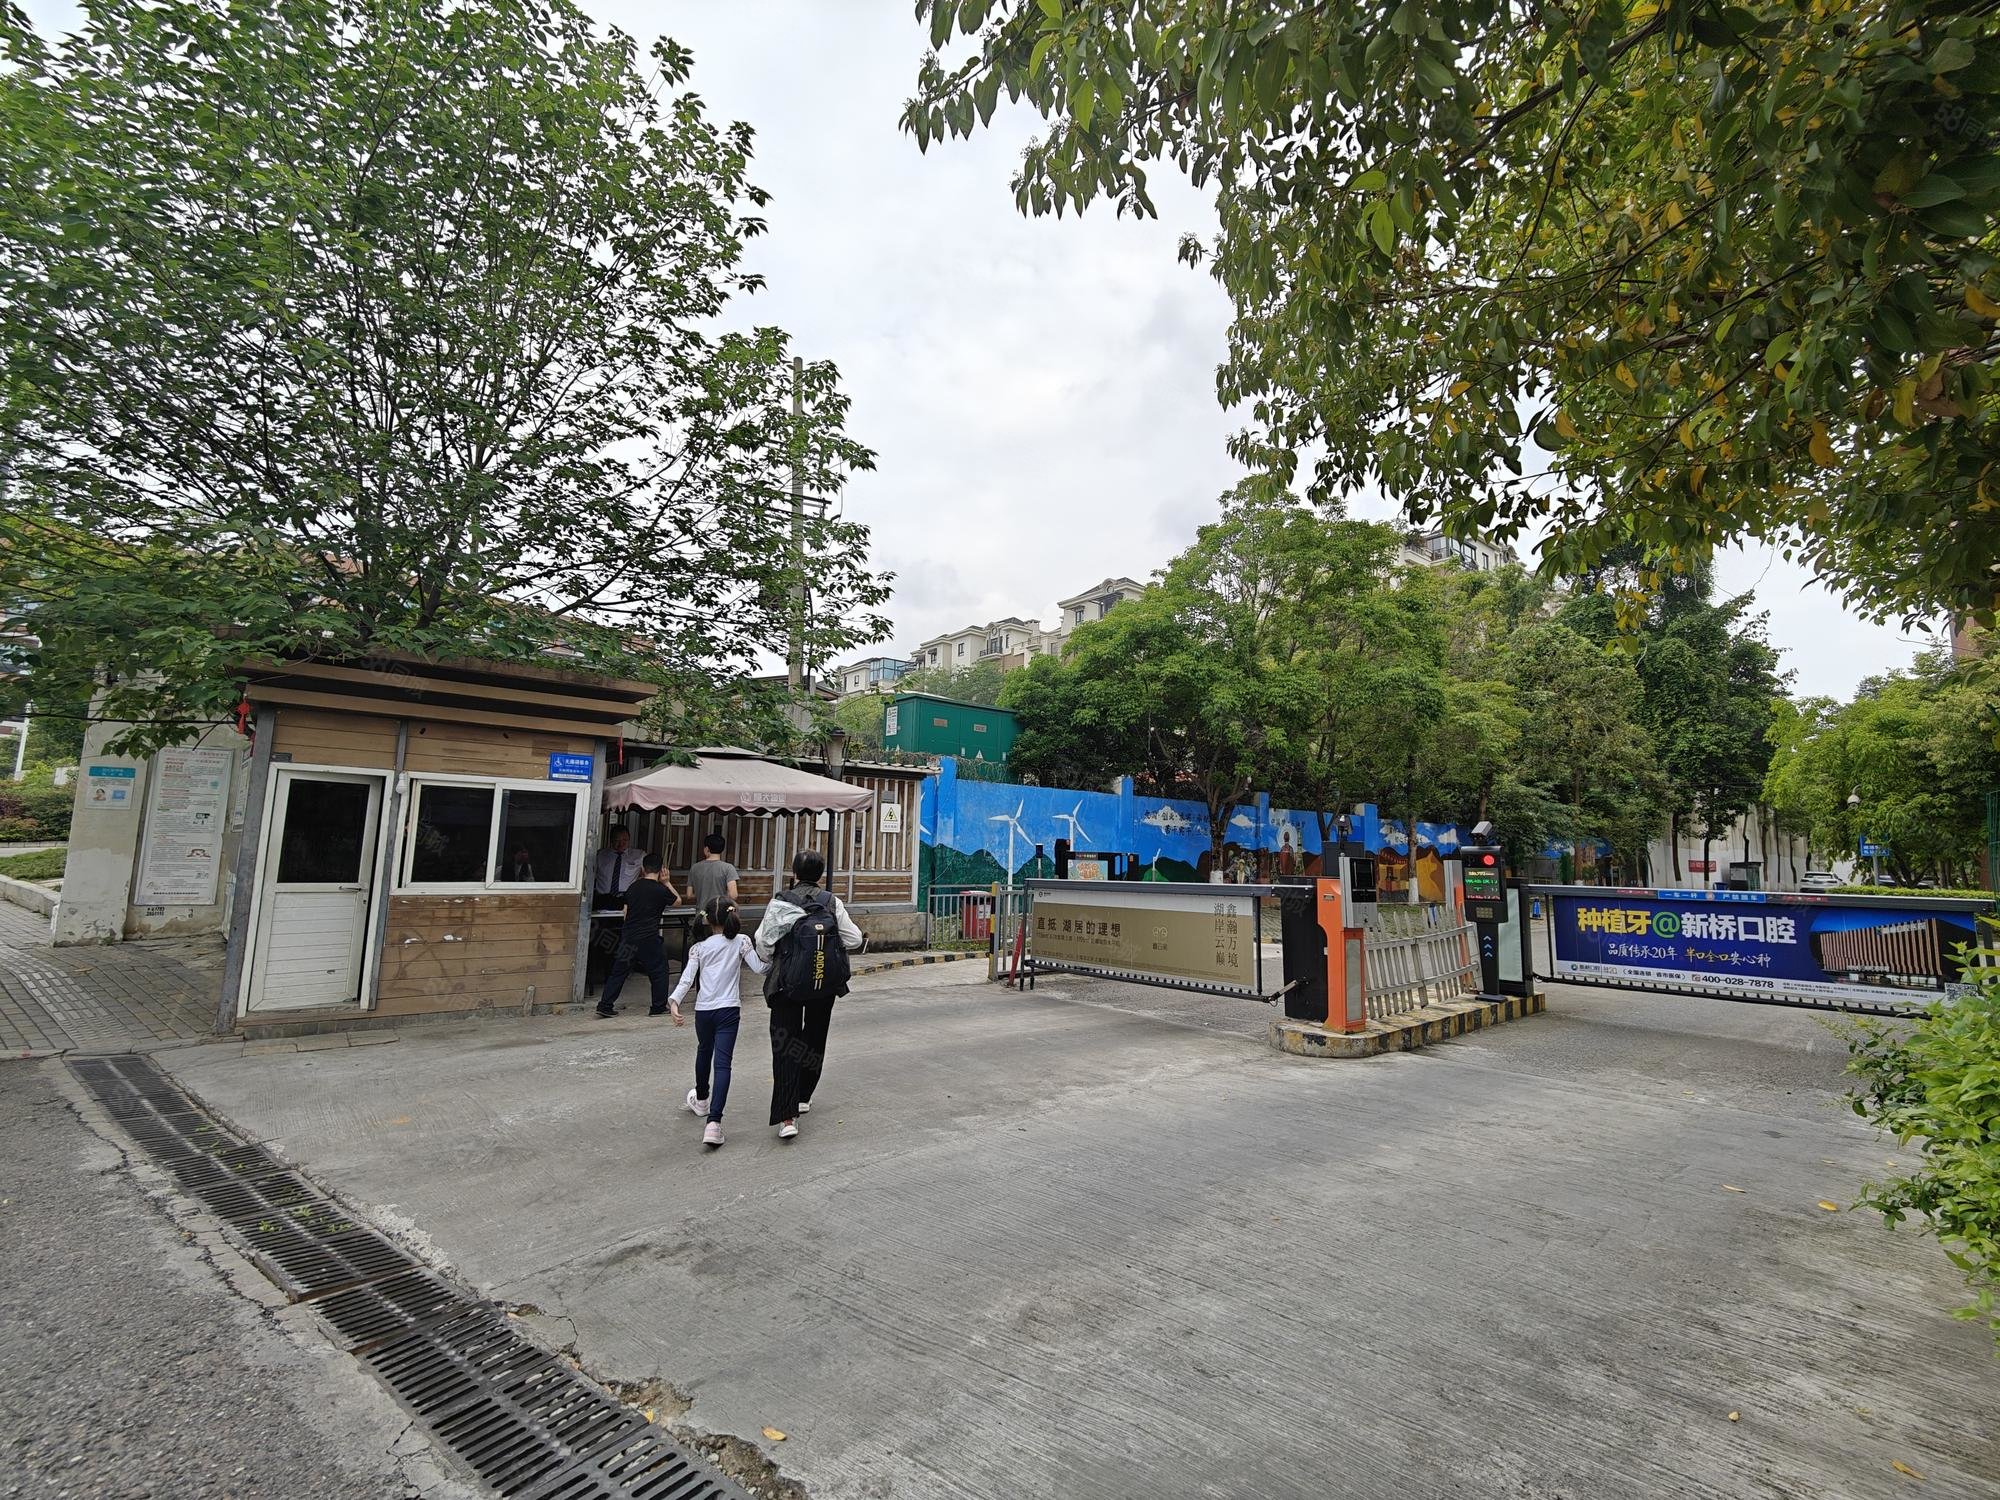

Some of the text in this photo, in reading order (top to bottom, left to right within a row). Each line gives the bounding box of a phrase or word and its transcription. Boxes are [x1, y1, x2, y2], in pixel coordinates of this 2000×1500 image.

[1062, 919, 1121, 937] 湖居的理想
[1577, 907, 1797, 944] 种植牙@新桥口腔
[815, 950, 825, 980] ADIDAS
[1607, 943, 1771, 968] 品质传承20年 半口全口安心种
[1702, 975, 1774, 988] 400-028-7878
